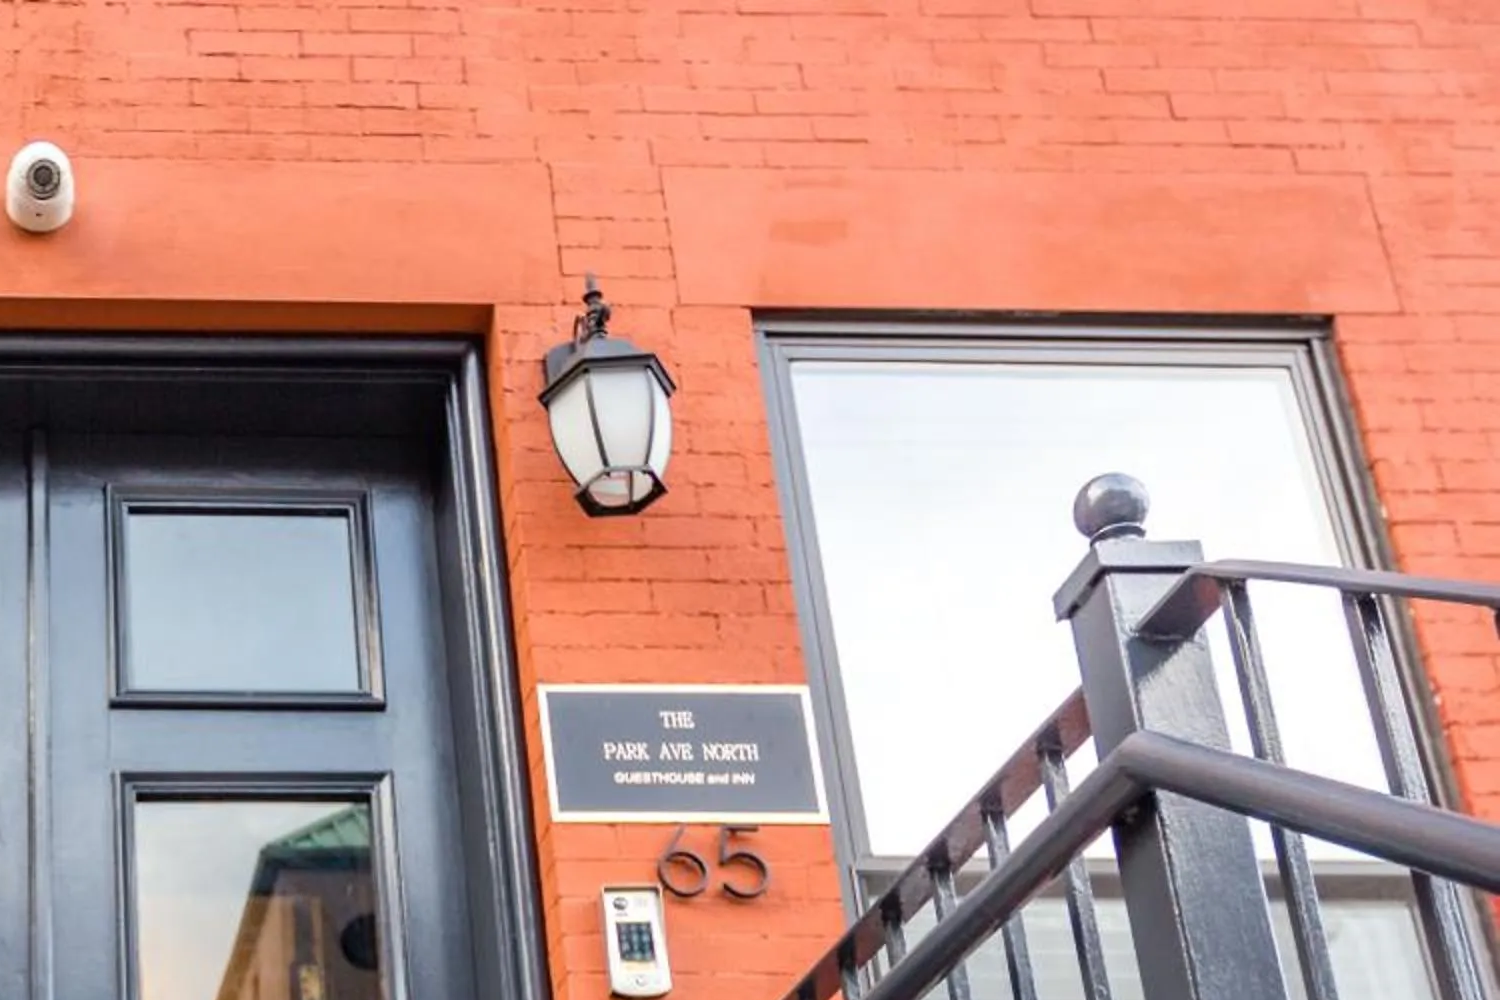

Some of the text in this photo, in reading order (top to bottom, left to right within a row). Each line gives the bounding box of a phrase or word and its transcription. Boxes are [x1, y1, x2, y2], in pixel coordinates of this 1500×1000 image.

[659, 711, 695, 729] THE
[603, 742, 759, 762] PARK AVE NORTH
[613, 772, 755, 785] GUESTHOUSE and INN
[658, 823, 769, 899] 65
